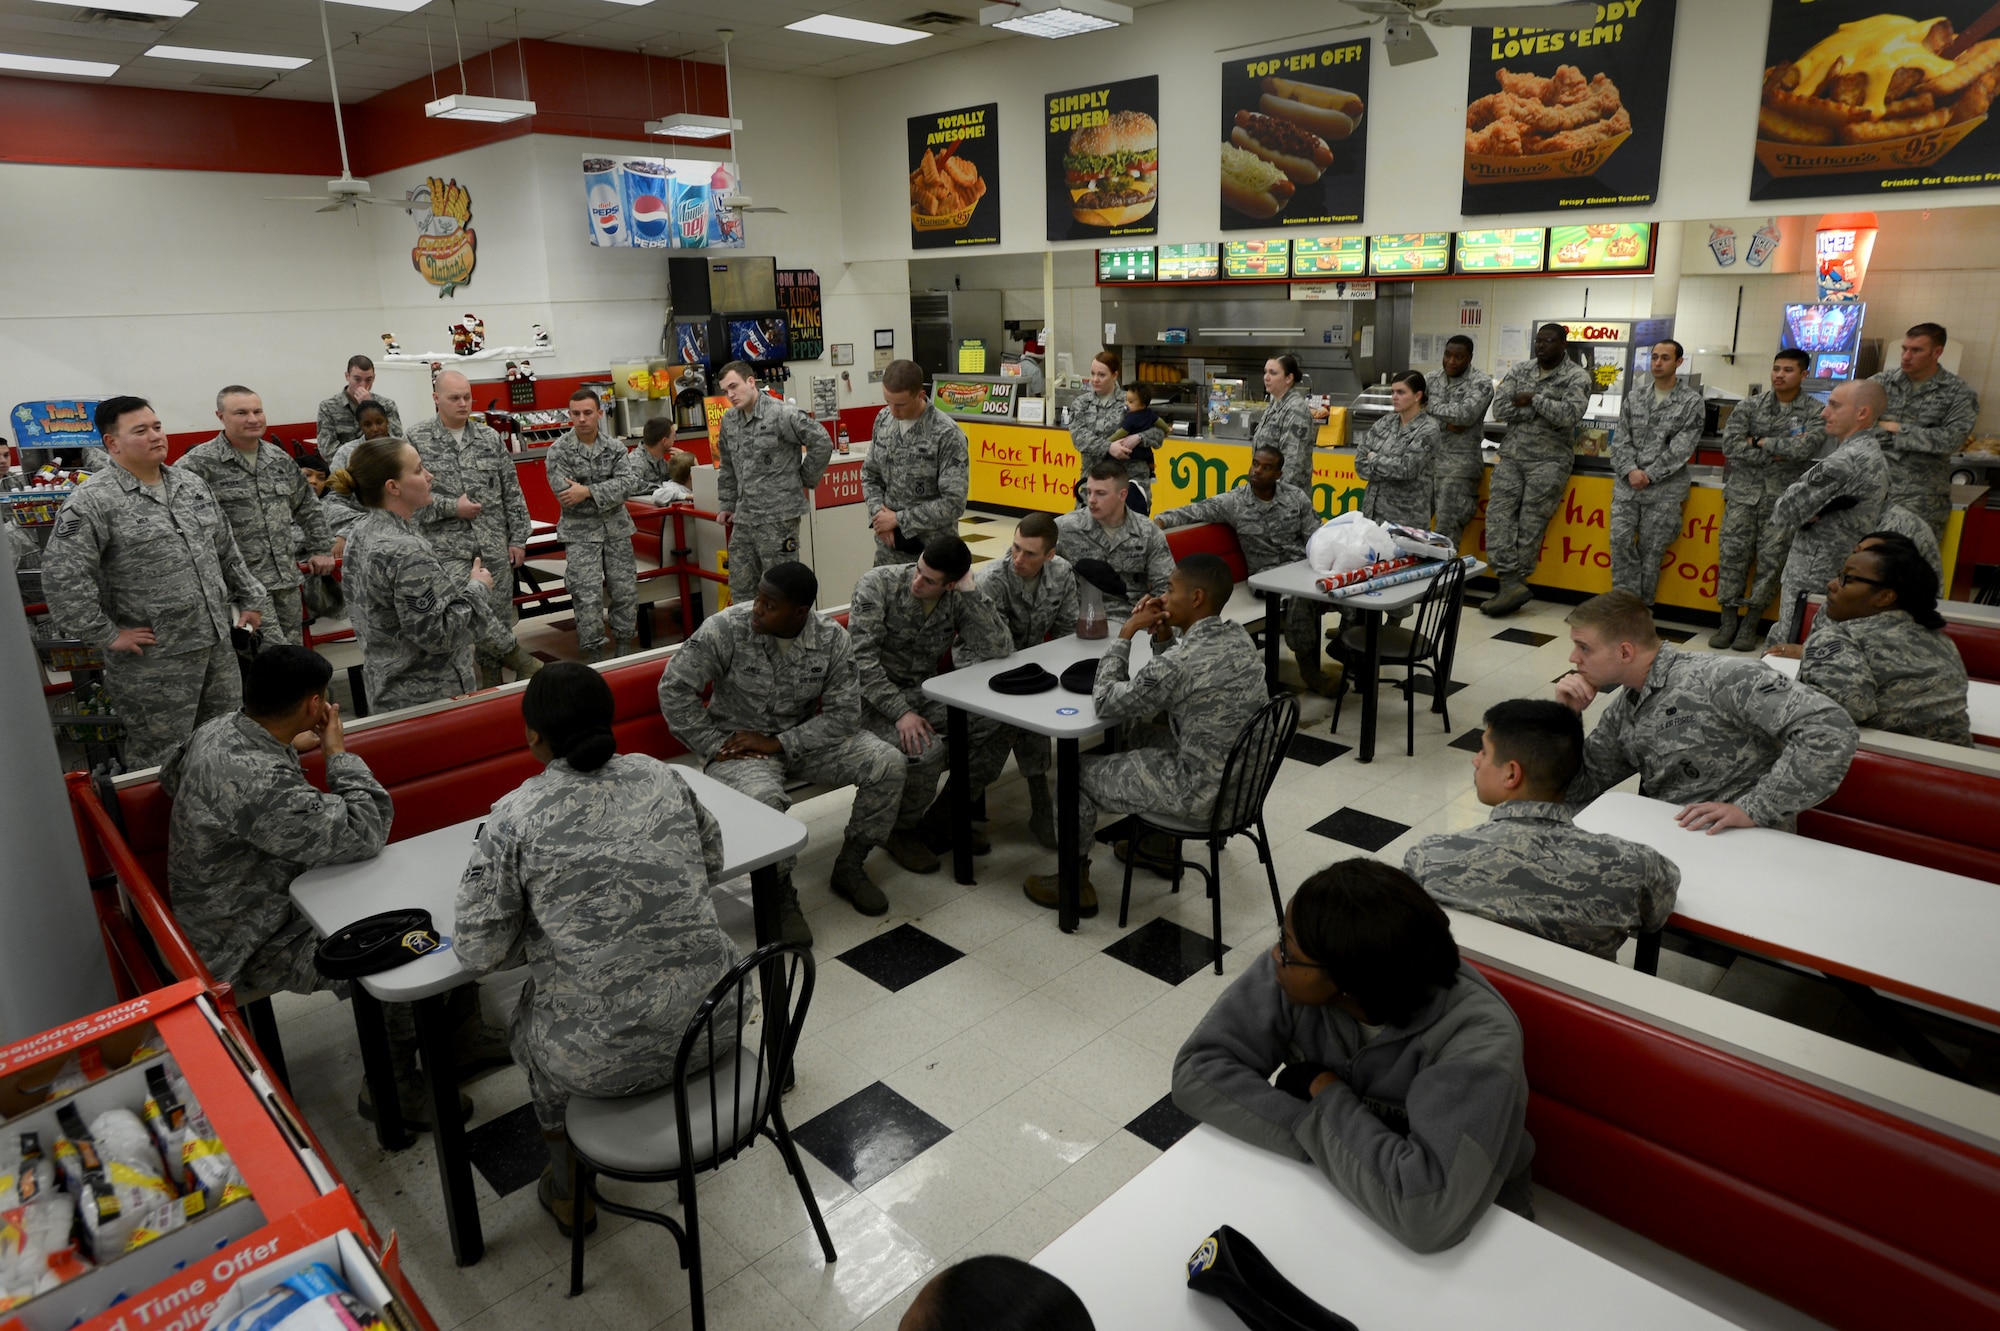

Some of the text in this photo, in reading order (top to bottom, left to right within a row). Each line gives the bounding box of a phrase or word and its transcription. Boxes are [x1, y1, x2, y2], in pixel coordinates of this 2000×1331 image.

[1491, 32, 1564, 60] LOVES
[1247, 58, 1281, 78] TOP
[1320, 45, 1362, 66] OFF!
[1050, 89, 1110, 115] SIMPLY
[937, 110, 985, 129] TOTALLY
[1050, 109, 1110, 133] SUPER!
[927, 125, 986, 145] AWESOME!
[1903, 135, 1938, 160] 95
[1570, 149, 1596, 168] 95
[1776, 153, 1881, 170] Nathan's
[1470, 162, 1552, 178] Nathan's
[1881, 172, 2000, 188] Crinkle Cut Cheese Fri
[1586, 196, 1617, 204] Chicken
[1618, 194, 1650, 203] Tenders
[592, 205, 620, 216] PEPSI
[633, 237, 667, 248] PEPSI
[1820, 230, 1856, 253] ICEE
[797, 272, 818, 286] HARD
[778, 287, 787, 307] E
[789, 287, 813, 307] KIND
[785, 307, 821, 328] AZING
[801, 328, 821, 339] WILL
[792, 341, 822, 359] PPEN
[1819, 359, 1849, 370] Cherry
[992, 384, 1011, 396] HOT
[45, 402, 88, 419] Tum-E
[982, 401, 1009, 413] DOGS
[982, 438, 1076, 468] More Than
[1000, 469, 1036, 493] Best
[832, 484, 858, 498] YOU
[95, 998, 150, 1022] While
[13, 1007, 148, 1063] Limited Time
[132, 1237, 280, 1326] Time Offer
